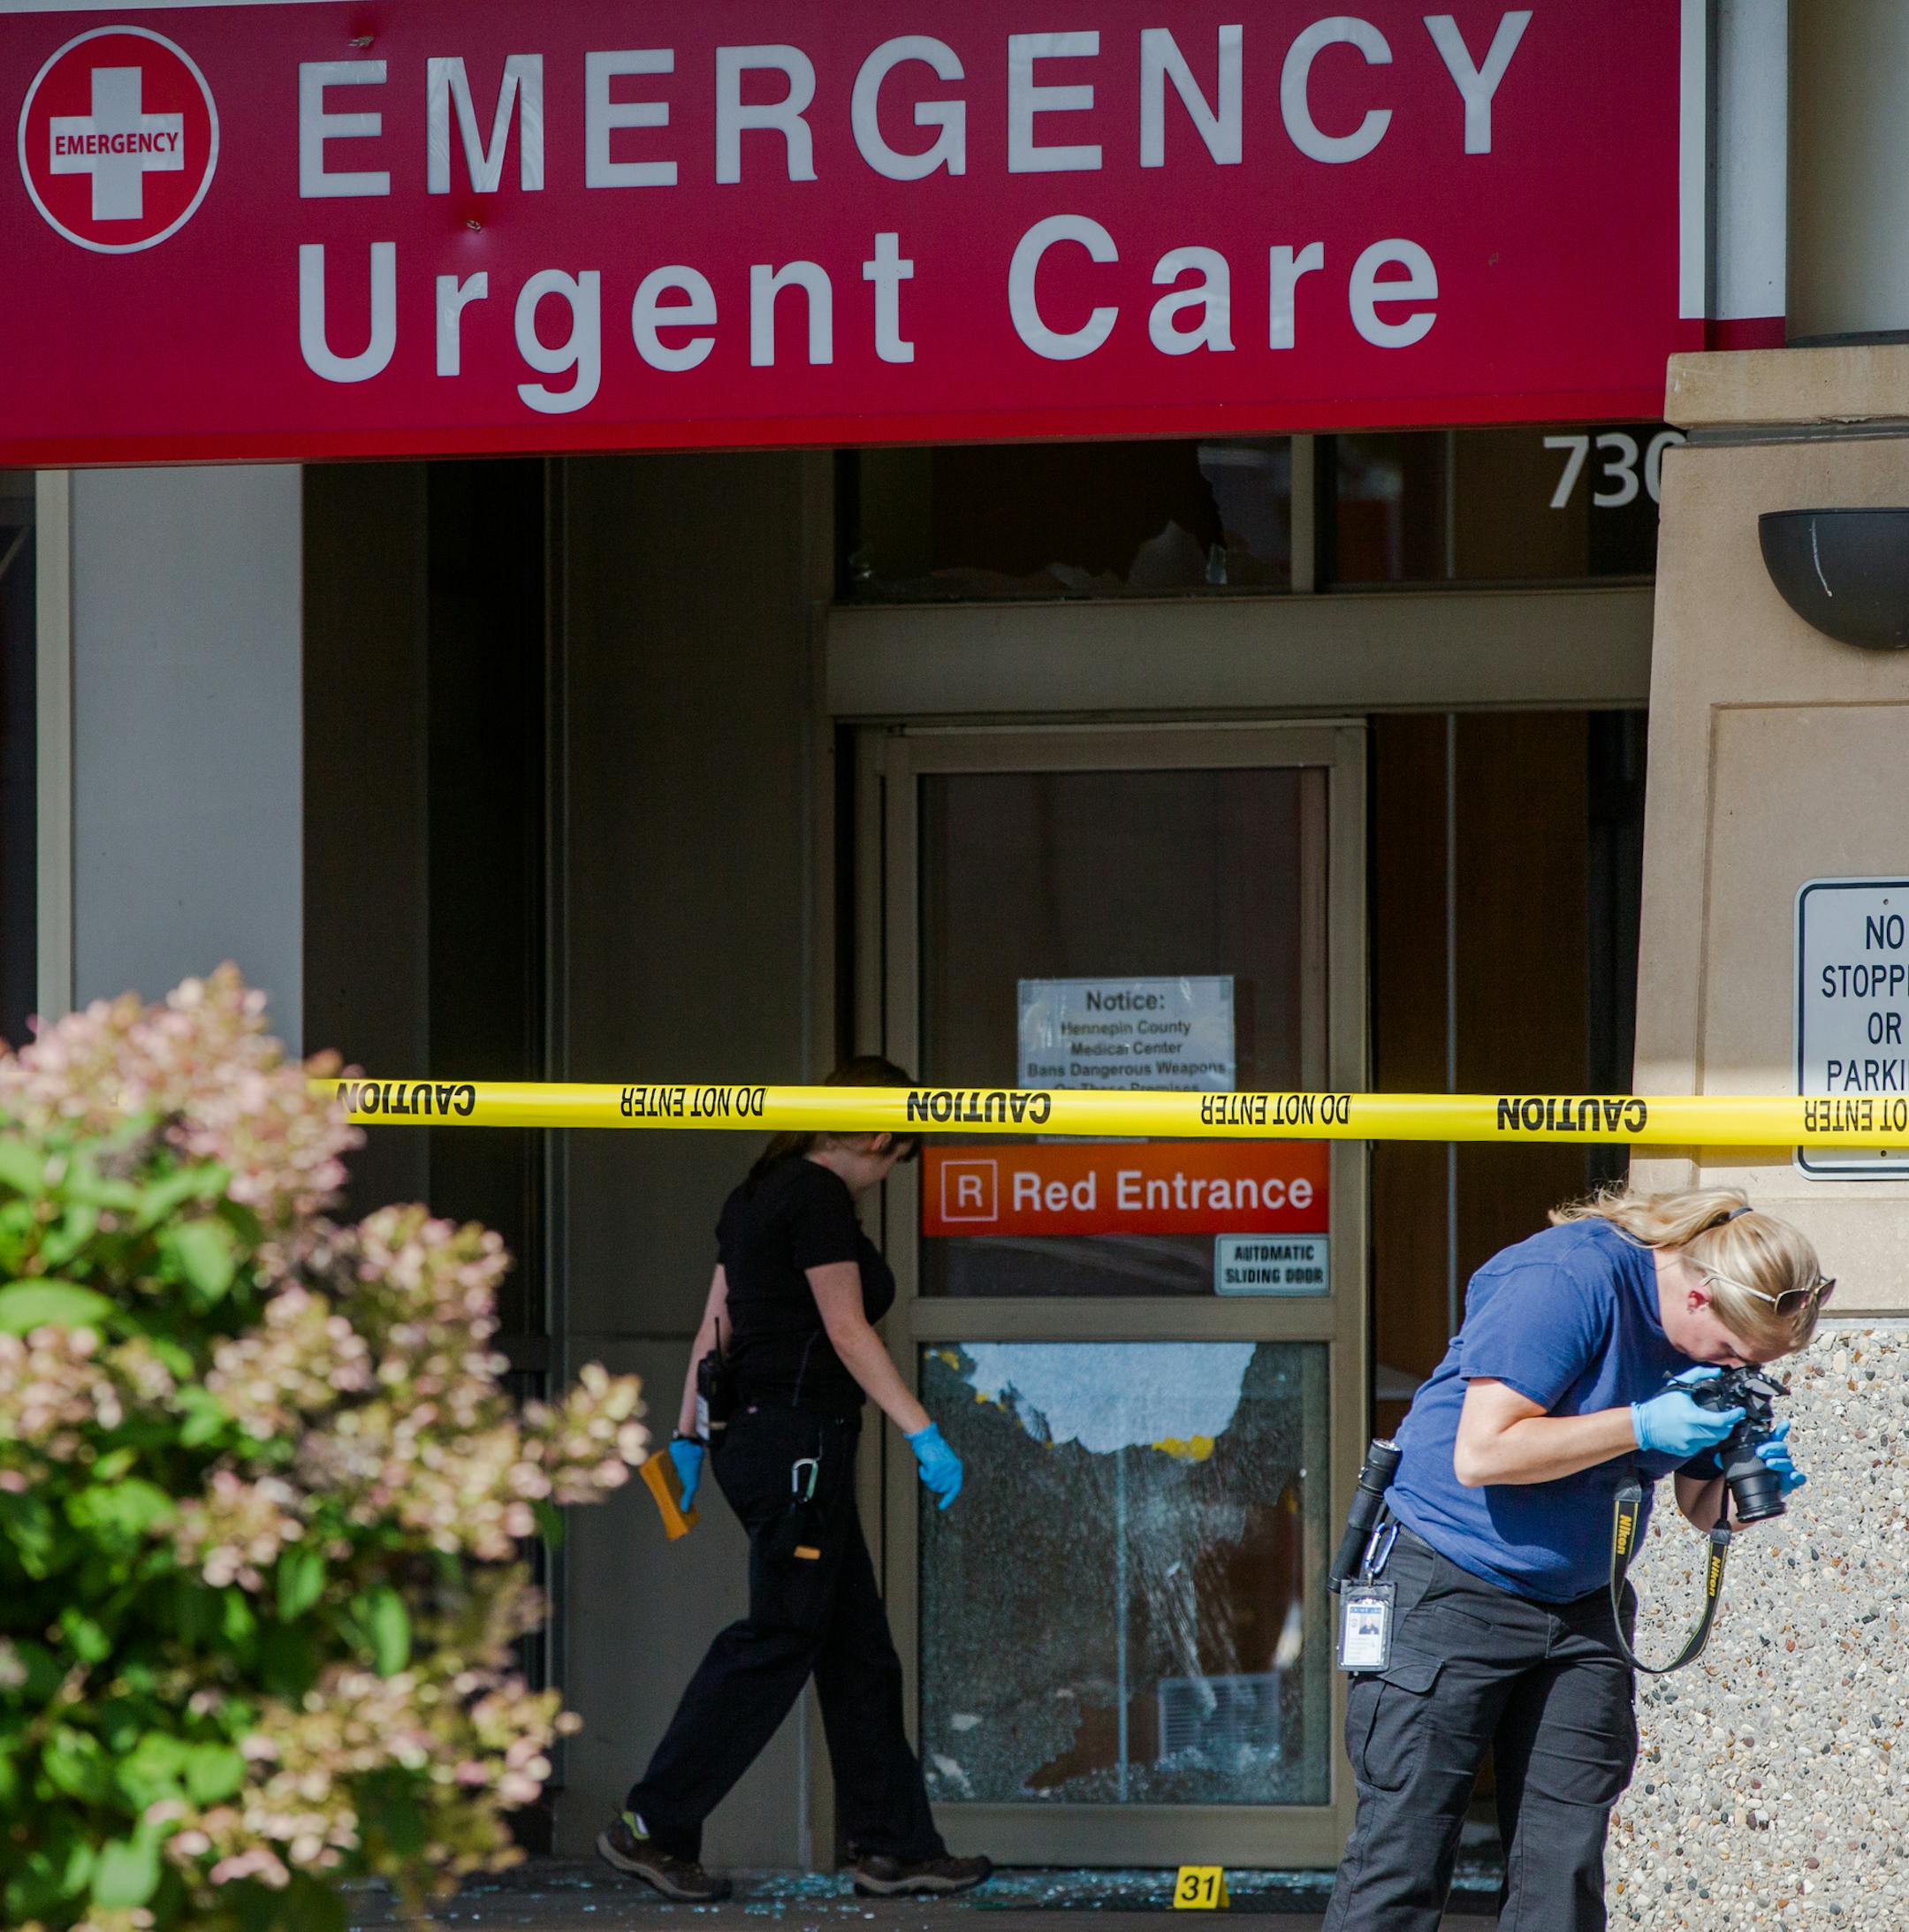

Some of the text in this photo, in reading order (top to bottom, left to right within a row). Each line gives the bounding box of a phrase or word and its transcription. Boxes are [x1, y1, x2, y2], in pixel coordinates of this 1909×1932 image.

[299, 11, 1533, 199] EMERGENCY
[56, 132, 179, 156] EMERGENCY
[299, 215, 1439, 414] Urgent Care
[1866, 914, 1905, 949] NO
[1822, 964, 1909, 998] STOPP
[1086, 990, 1165, 1011] Notice:
[1061, 1019, 1191, 1038] Hennepin County
[1867, 1012, 1902, 1044] OR
[1071, 1041, 1183, 1055] Medical Center
[1028, 1060, 1225, 1079] Bans Dangerous Weapons
[1827, 1059, 1906, 1092] PARKI
[337, 1083, 475, 1116] CAUTION
[620, 1087, 766, 1117] DO NOT ENTER
[907, 1092, 1051, 1124] CAUTION
[1201, 1095, 1350, 1125] DO NOT ENTER
[1497, 1098, 1647, 1133] CAUTION
[1805, 1099, 1907, 1132] OT ENTER
[957, 1170, 1313, 1212] R Red Entrance
[1235, 1245, 1315, 1262] AUTOMATIC
[1225, 1267, 1324, 1284] SLIDING DOOR
[1617, 1514, 1631, 1555] Nikon
[1708, 1555, 1722, 1597] Nikon
[1181, 1875, 1215, 1902] 31
